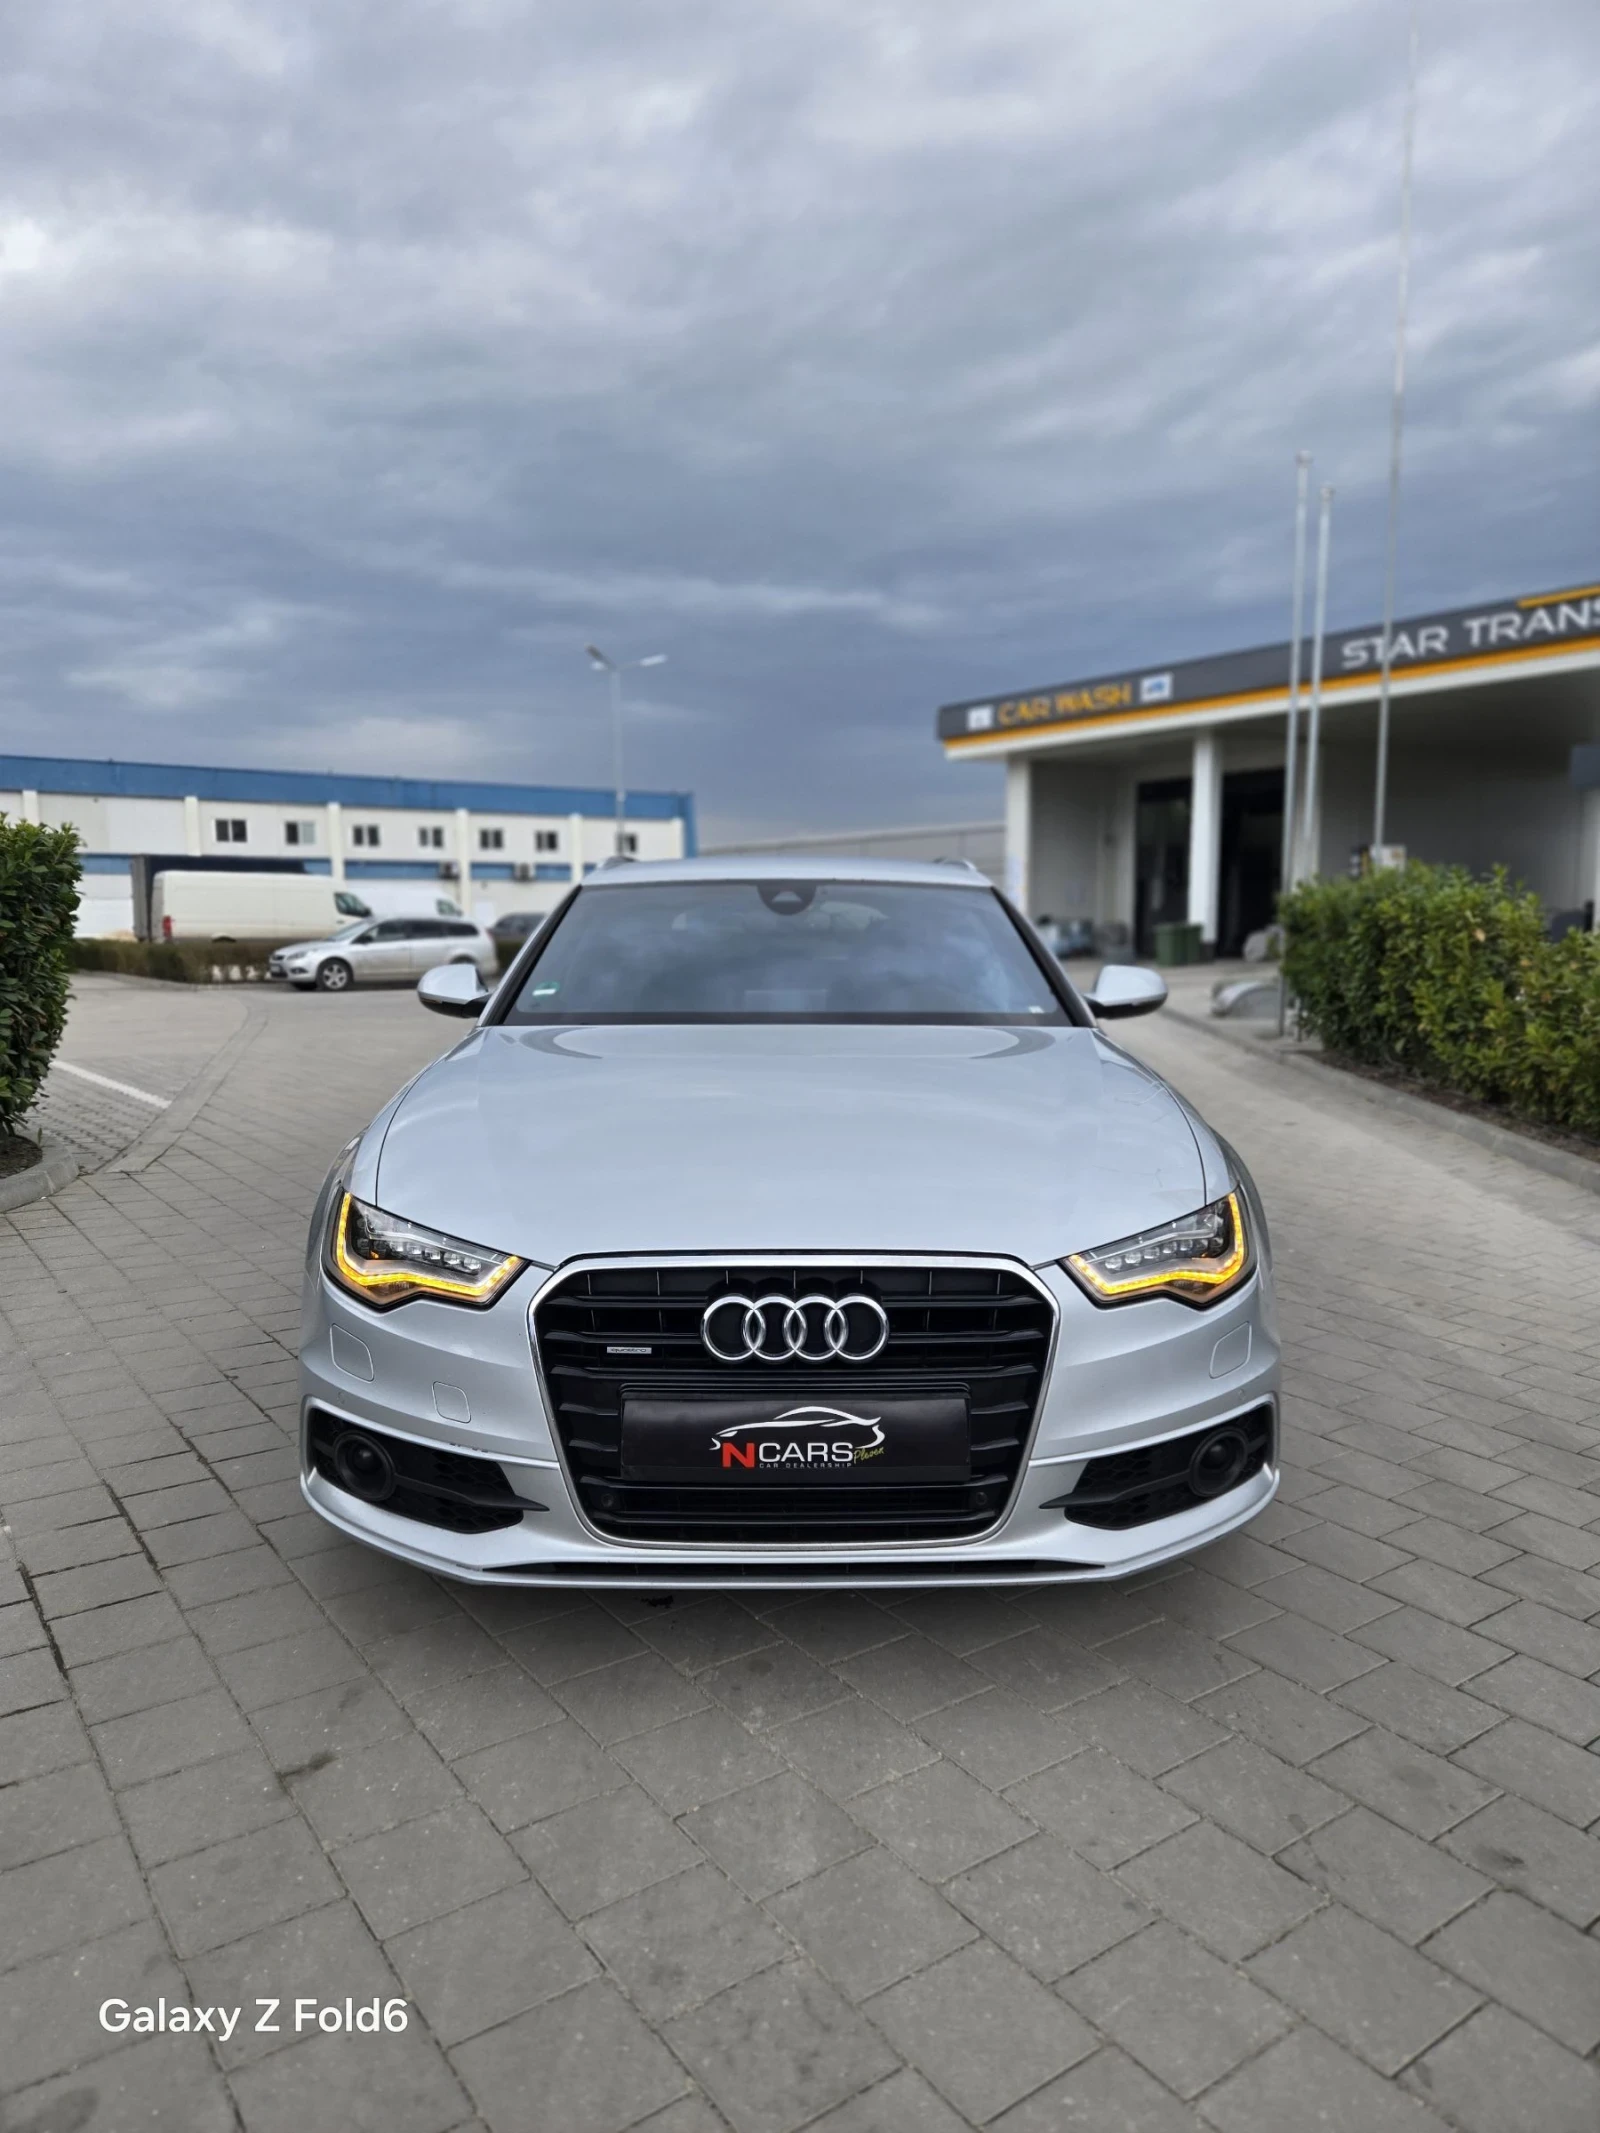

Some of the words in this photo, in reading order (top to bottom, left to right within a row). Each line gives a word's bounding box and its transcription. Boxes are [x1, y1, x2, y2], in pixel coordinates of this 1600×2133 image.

[1342, 625, 1448, 669] STAR
[1464, 598, 1600, 647] TRAN
[998, 696, 1050, 725] CAR
[1055, 683, 1132, 714] WASH
